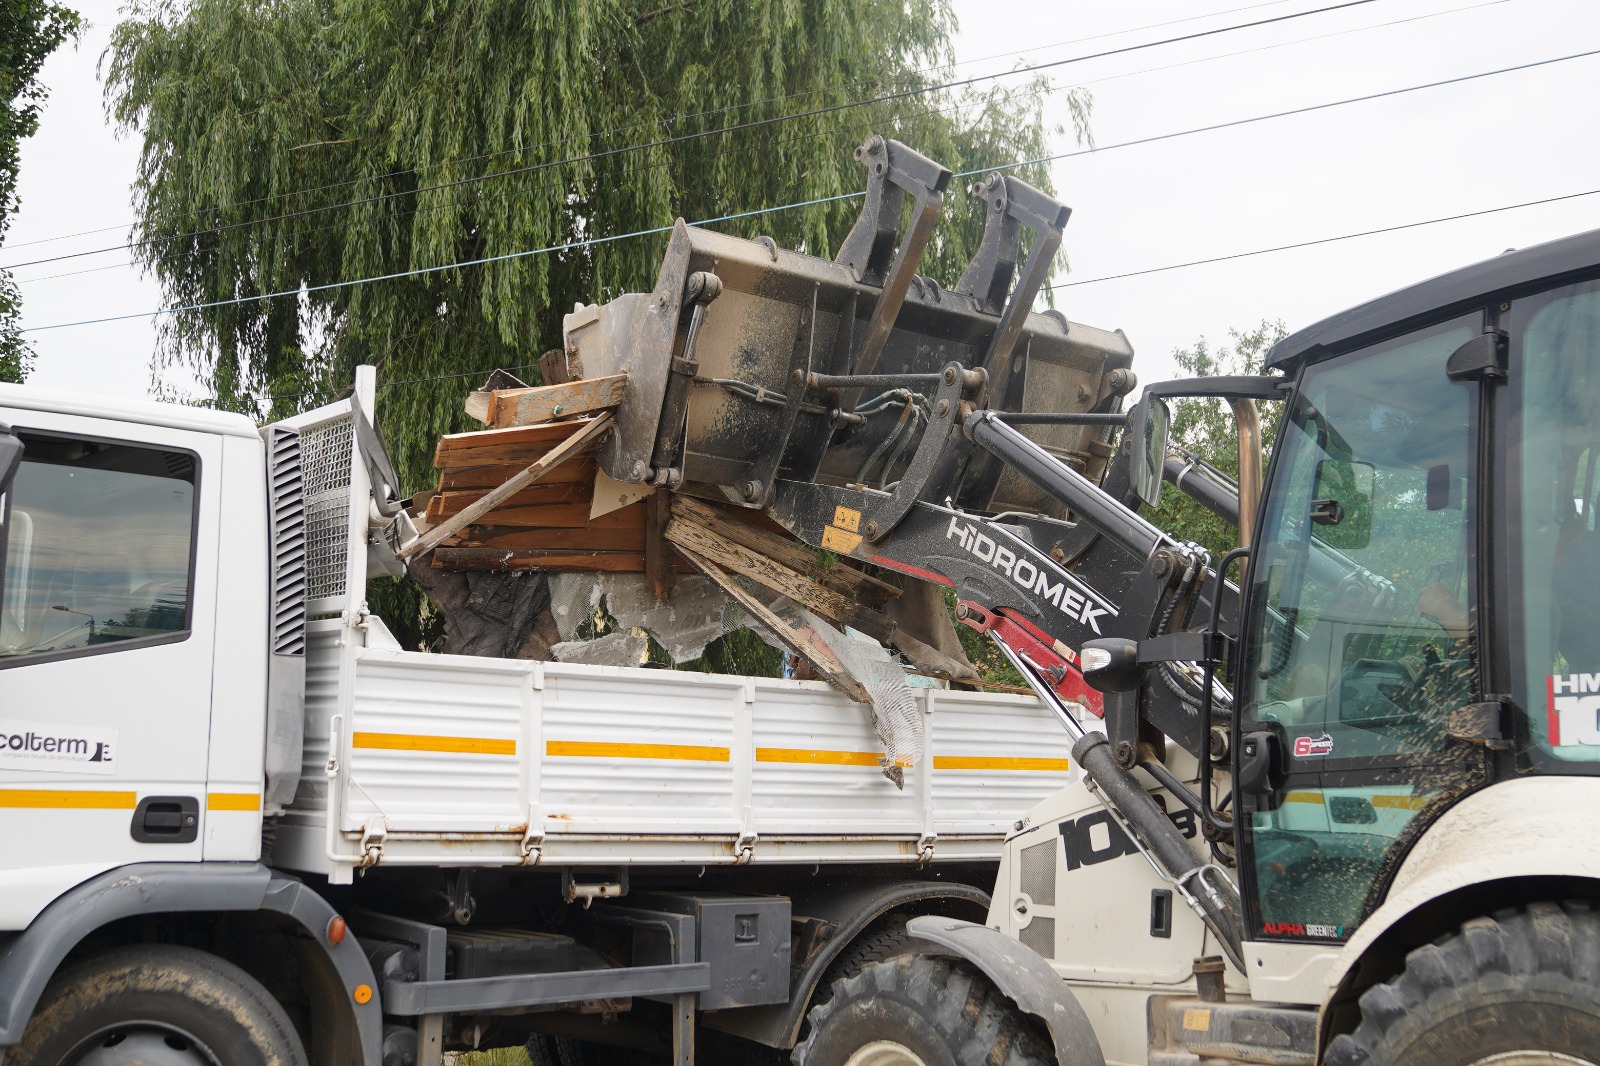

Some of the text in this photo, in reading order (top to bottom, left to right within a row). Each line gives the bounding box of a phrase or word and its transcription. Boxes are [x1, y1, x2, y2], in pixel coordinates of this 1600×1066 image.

[0, 732, 88, 754] colterm
[1263, 921, 1338, 938] ALPHA GREENTEC
